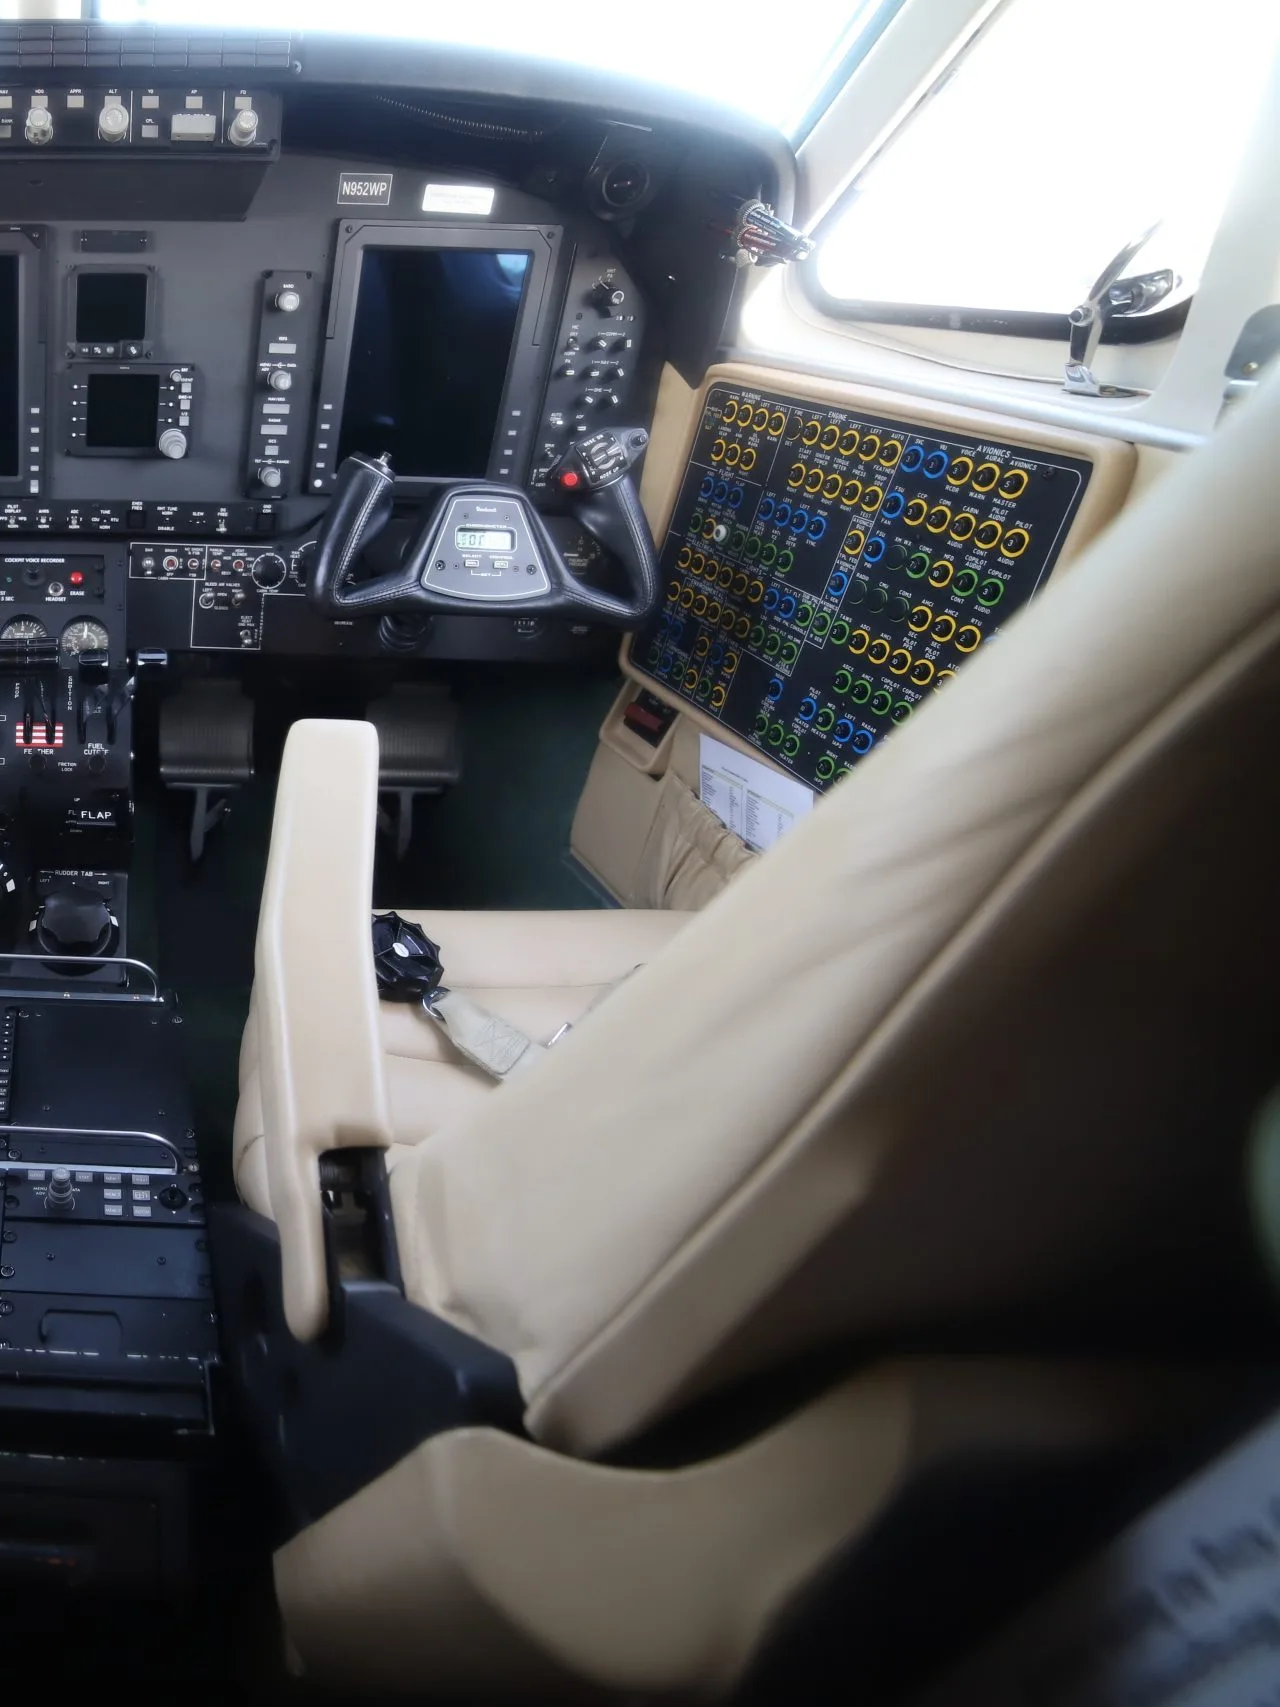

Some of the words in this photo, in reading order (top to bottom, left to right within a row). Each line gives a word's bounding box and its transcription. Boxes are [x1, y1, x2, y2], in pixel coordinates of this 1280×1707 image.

[342, 181, 387, 196] N952WP
[828, 411, 848, 421] ENGINE
[961, 449, 977, 457] VOICE
[976, 445, 1012, 459] AVIONICS
[984, 455, 1005, 464] AURAL
[1009, 460, 1038, 471] AVIONICS
[945, 485, 960, 493] RCDR
[968, 491, 986, 500] WARN
[992, 497, 1017, 508] MASTER
[991, 507, 1009, 516] PILOT
[988, 513, 1006, 522] AUDIO
[1015, 520, 1033, 530] PILOT
[946, 540, 963, 548] AUDIO
[972, 548, 988, 557] CONT
[964, 555, 987, 565] COPILOT
[997, 557, 1015, 566] AUDIO
[987, 569, 1012, 580] COPILOT
[950, 595, 965, 604] CONT
[973, 605, 991, 615] AUDIO
[924, 647, 940, 657] PILOT
[861, 722, 877, 734] RADAR
[81, 811, 112, 819] FLAP
